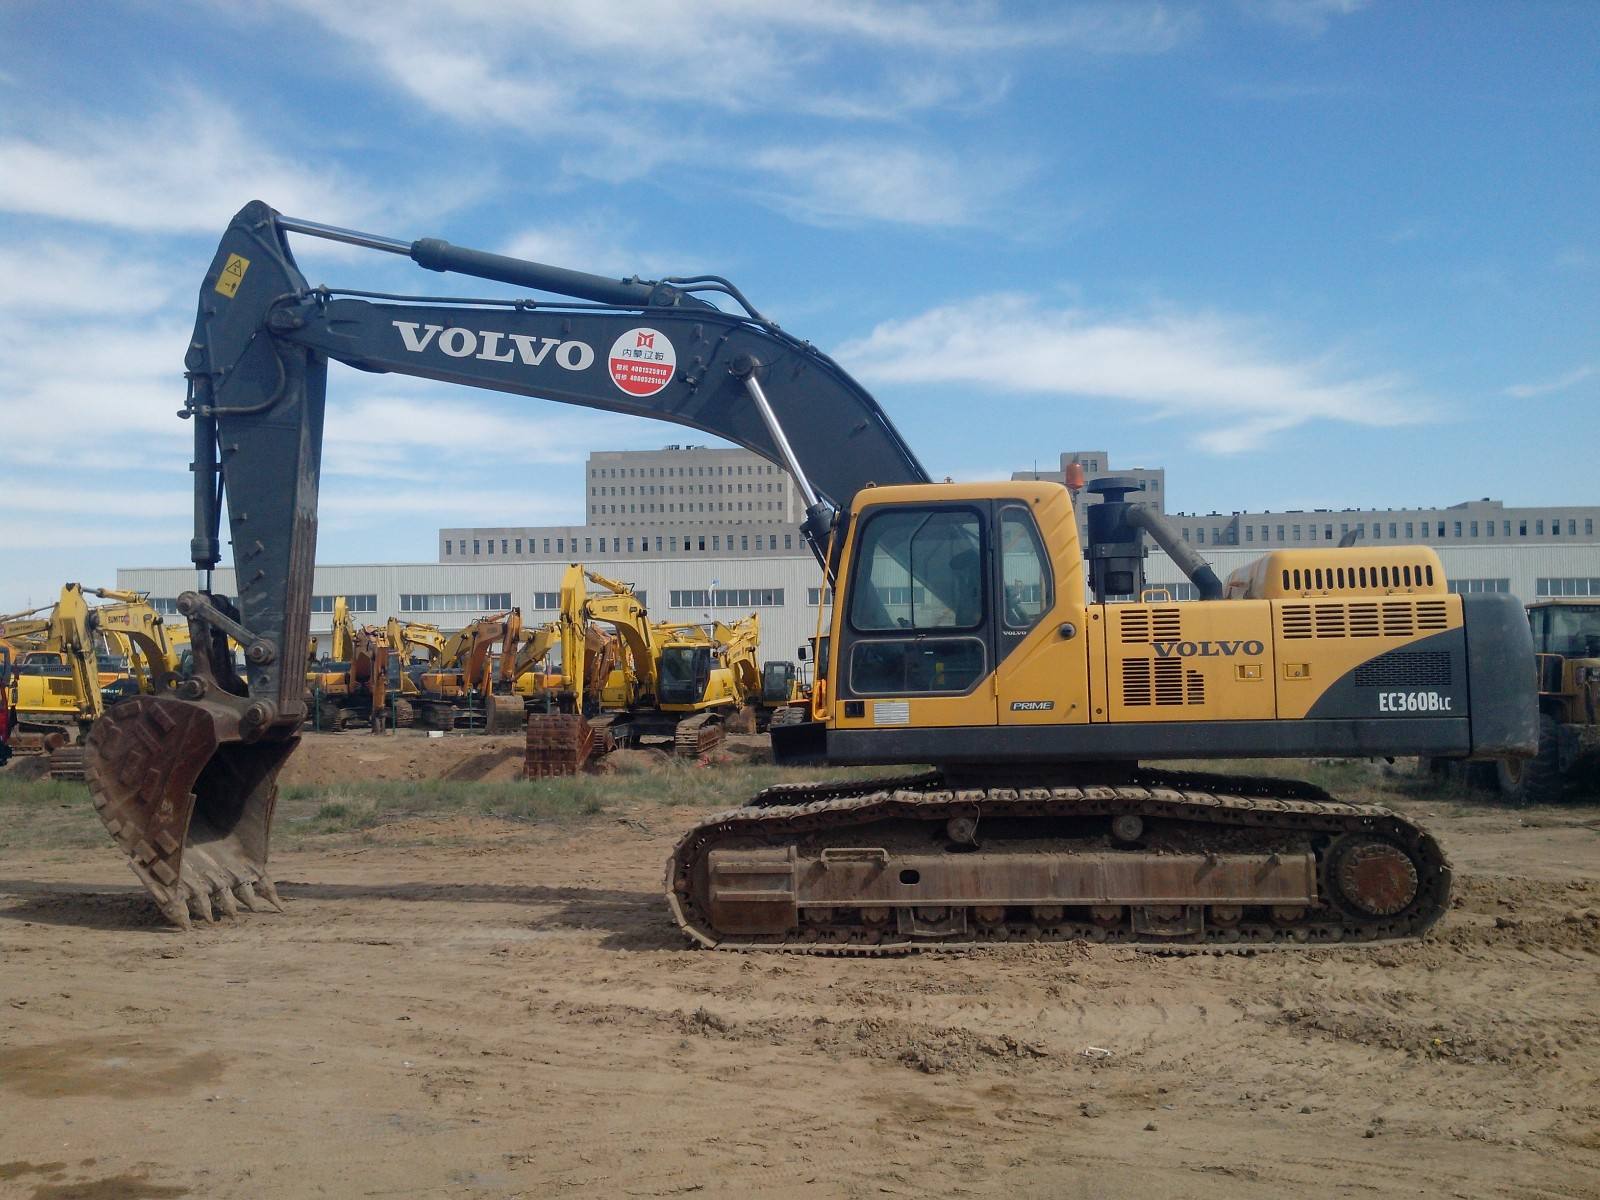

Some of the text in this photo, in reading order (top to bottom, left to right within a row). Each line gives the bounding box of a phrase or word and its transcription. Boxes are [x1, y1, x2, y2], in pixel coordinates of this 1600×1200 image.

[392, 320, 595, 371] VOLVO
[1149, 640, 1264, 657] VOLVO
[1013, 702, 1052, 710] PRIME
[1379, 692, 1451, 711] EC360BLC
